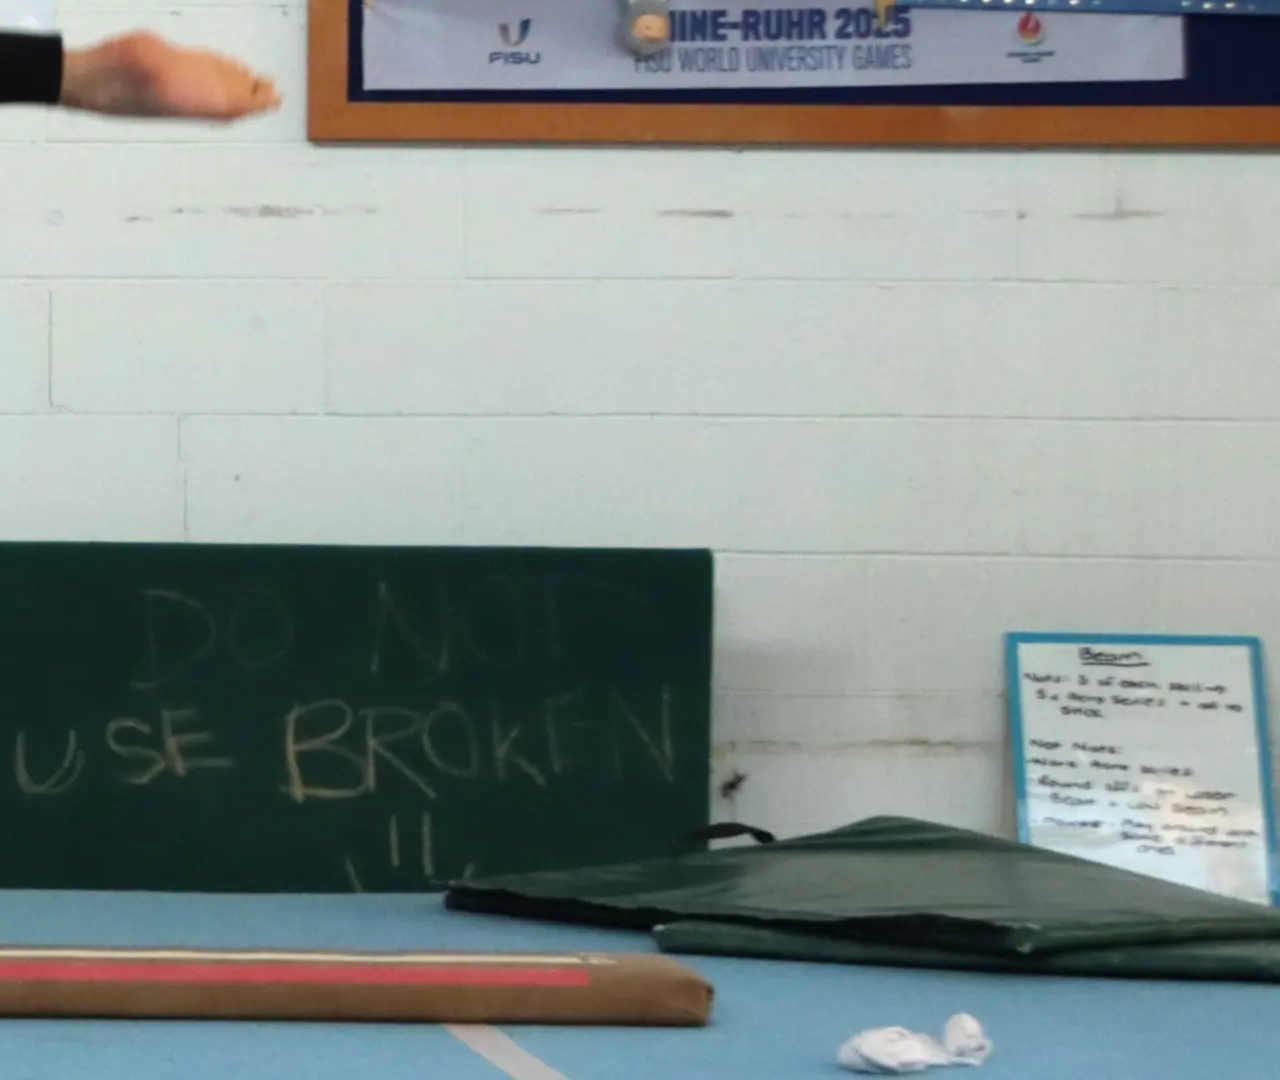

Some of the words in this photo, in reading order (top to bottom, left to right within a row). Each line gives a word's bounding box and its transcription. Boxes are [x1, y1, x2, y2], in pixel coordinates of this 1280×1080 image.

[488, 50, 542, 66] FISU
[678, 46, 740, 73] WORLD
[745, 45, 845, 71] UNIVERSITY
[852, 44, 913, 70] GAMES
[130, 583, 296, 689] DO
[14, 707, 235, 796] USE
[279, 684, 677, 805] BROKEN
